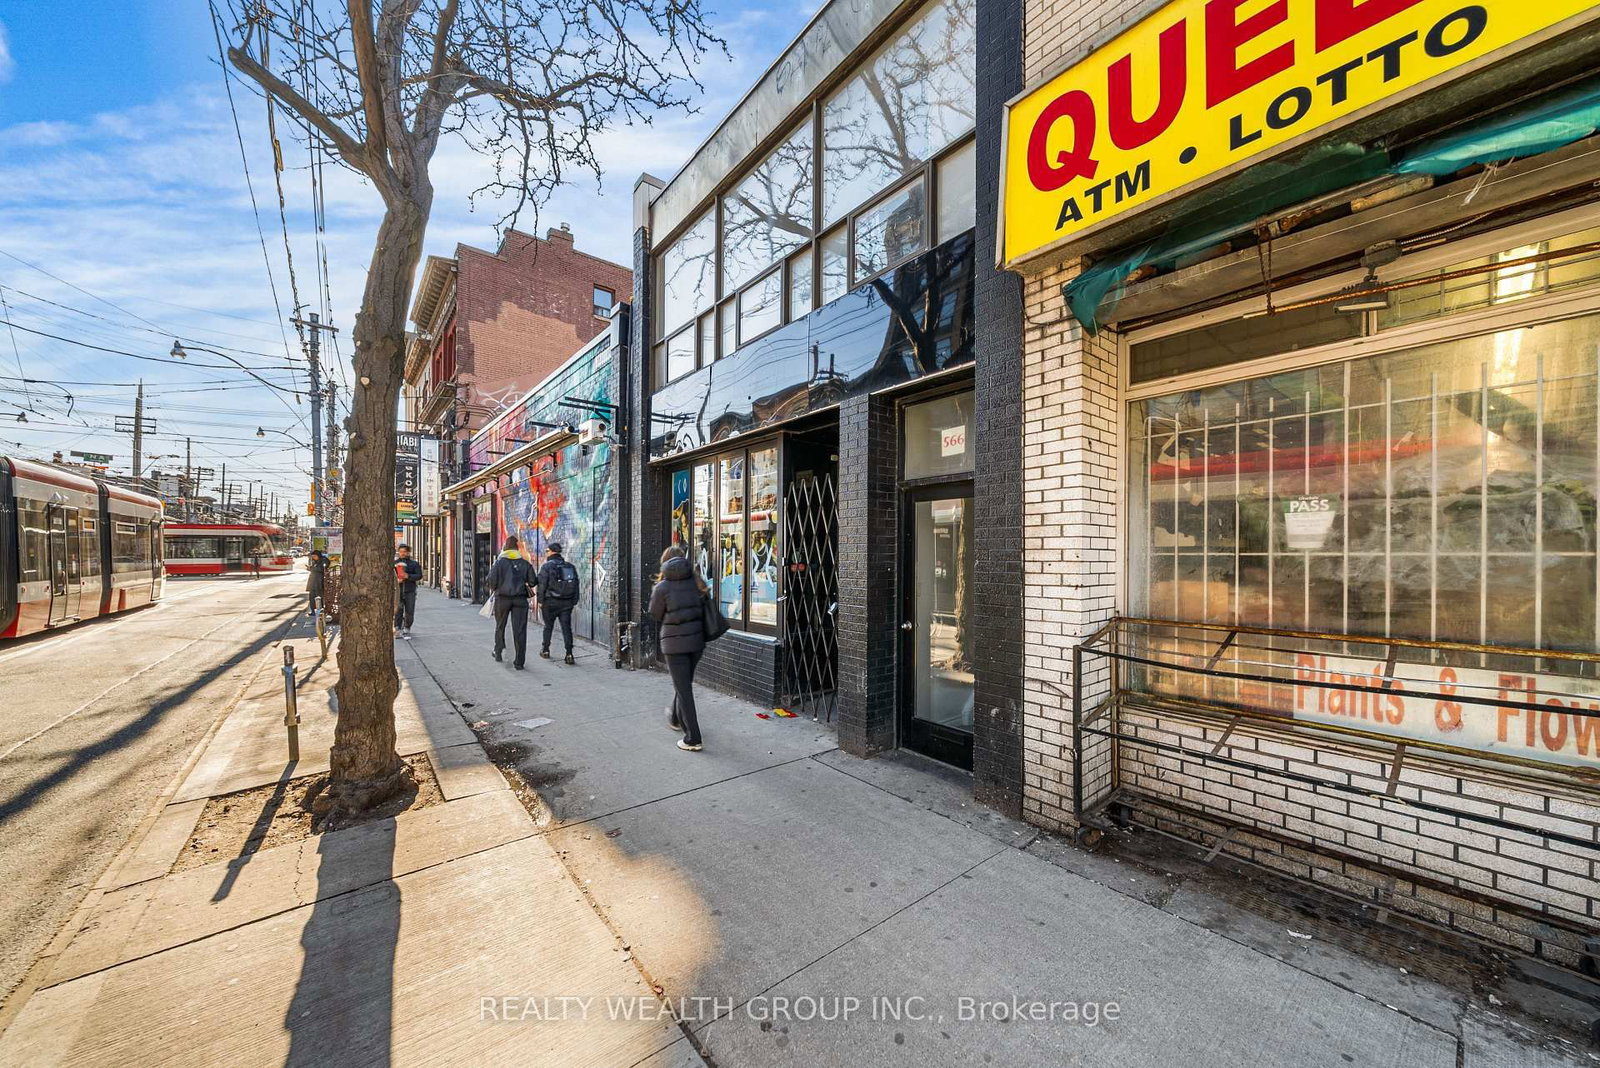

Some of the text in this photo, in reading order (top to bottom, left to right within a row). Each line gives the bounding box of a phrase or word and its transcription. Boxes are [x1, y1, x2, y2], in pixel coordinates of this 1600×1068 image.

[1027, 0, 1424, 192] QUE
[1055, 5, 1488, 231] ATM LOTTO
[943, 434, 965, 448] 566
[1290, 499, 1330, 512] PASS
[1296, 653, 1405, 725] Plants
[1434, 667, 1464, 734] &
